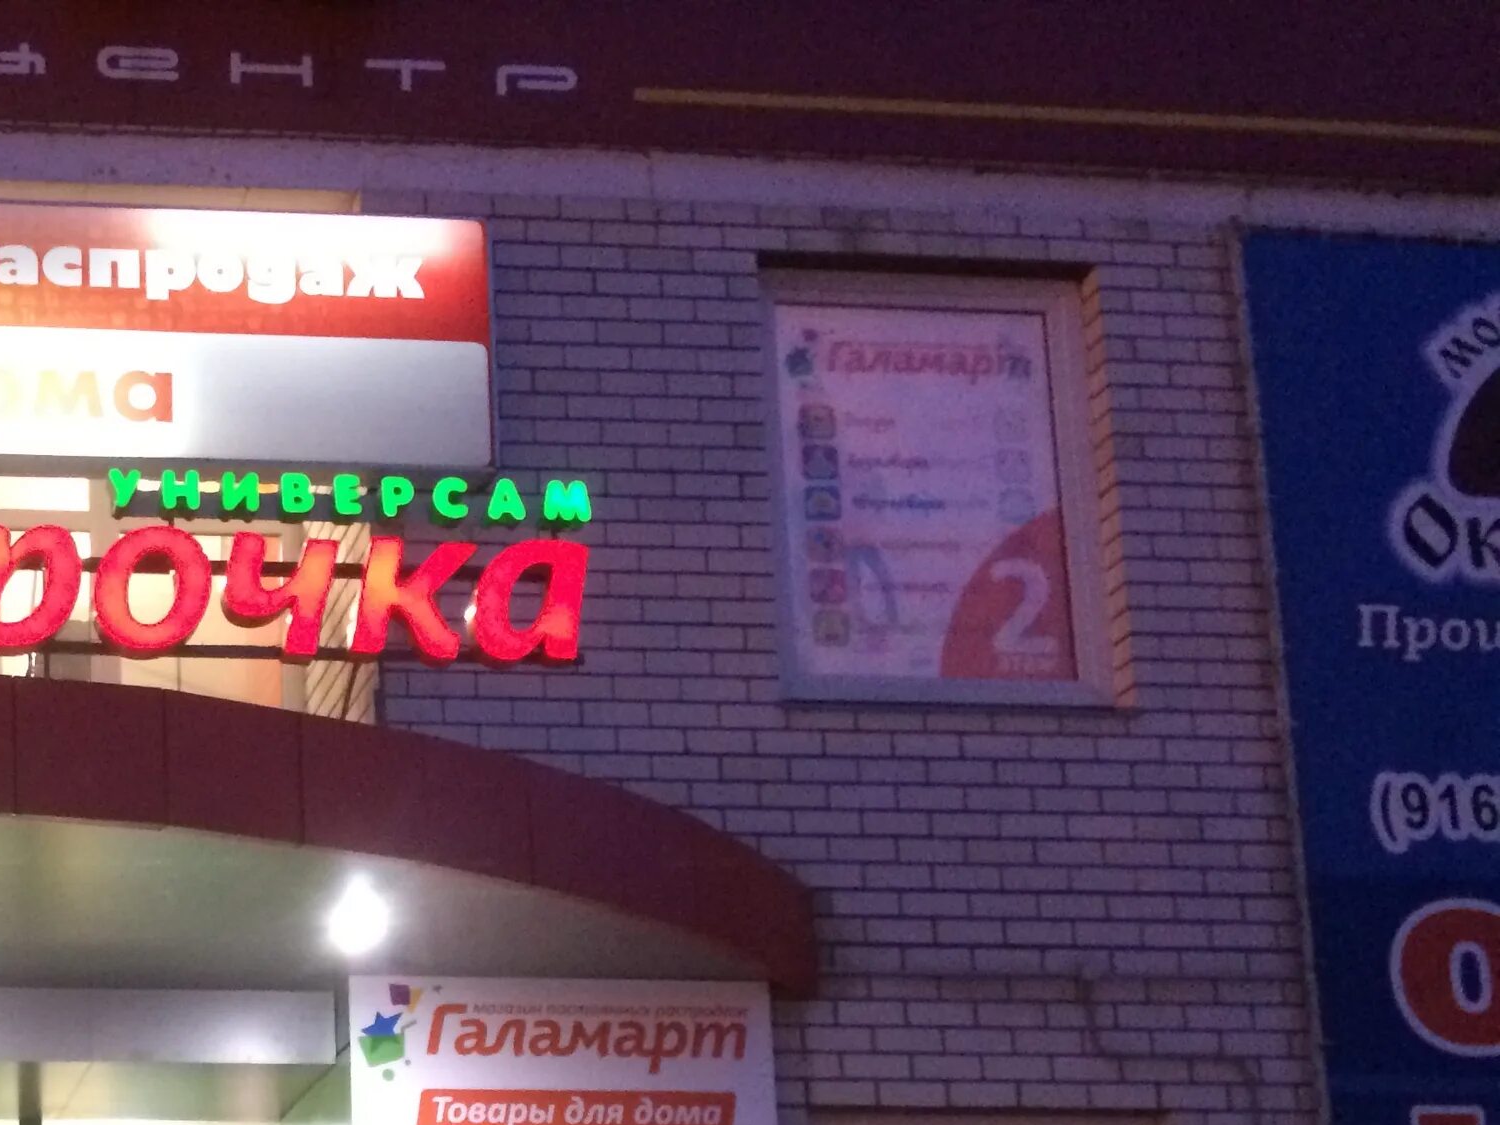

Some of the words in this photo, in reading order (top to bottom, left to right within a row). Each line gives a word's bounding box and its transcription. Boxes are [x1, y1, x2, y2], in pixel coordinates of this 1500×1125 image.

[108, 467, 592, 523] УНИВЕРСАМ
[990, 557, 1060, 655] 2
[426, 1003, 748, 1074] Галамарт
[563, 1097, 624, 1125] для
